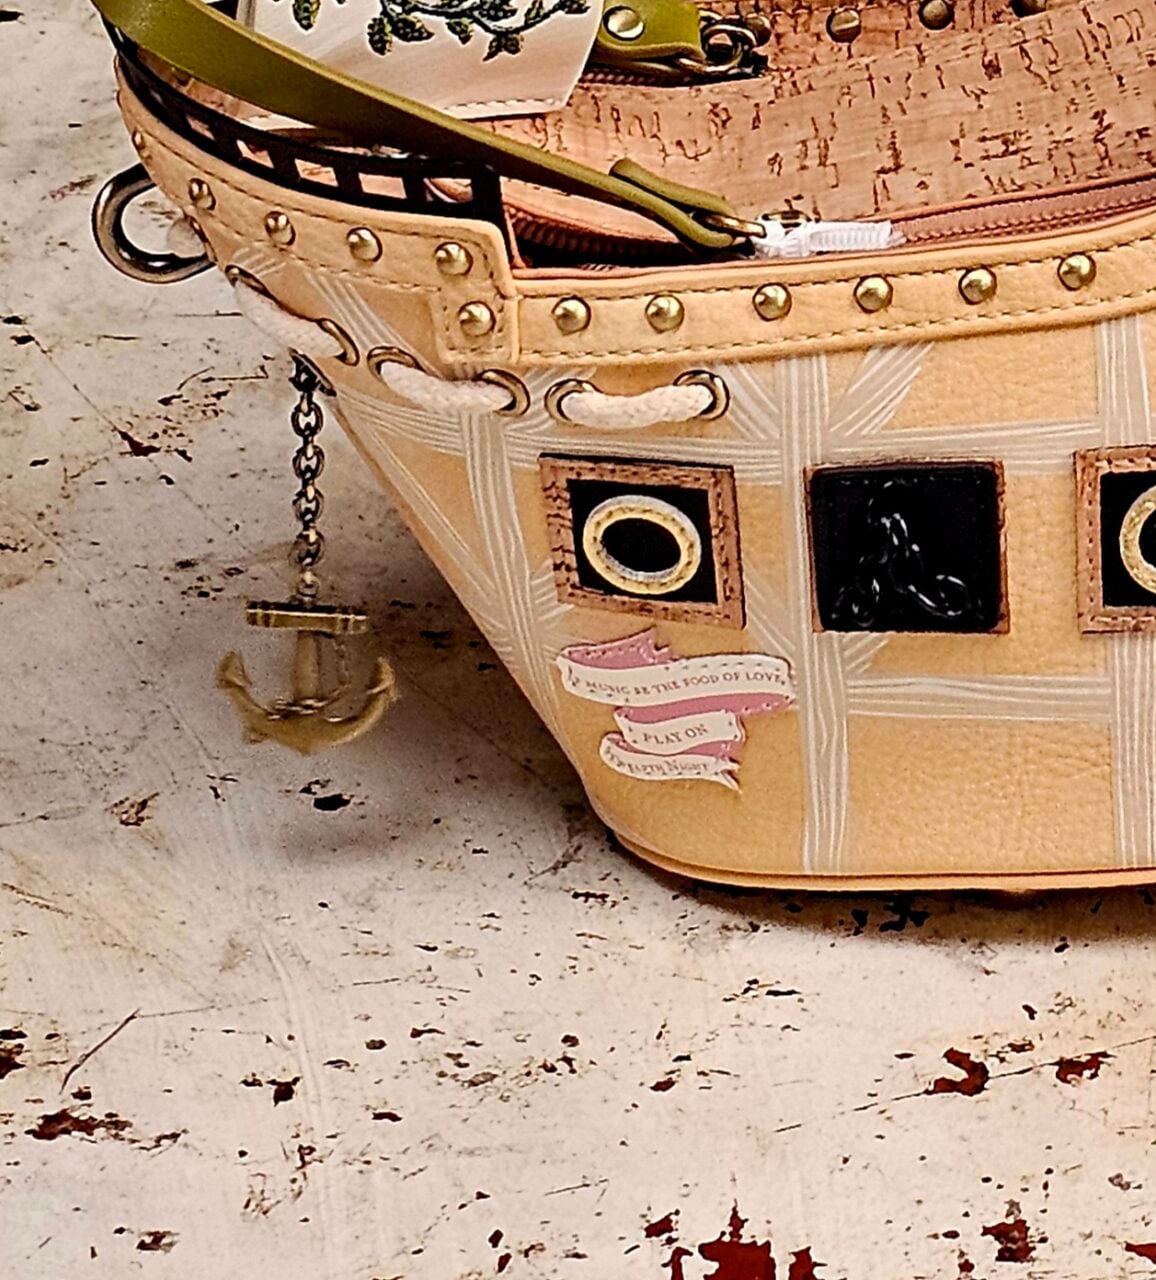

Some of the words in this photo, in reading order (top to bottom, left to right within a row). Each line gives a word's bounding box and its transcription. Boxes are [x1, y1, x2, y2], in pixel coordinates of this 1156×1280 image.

[651, 680, 681, 694] THE
[682, 674, 719, 688] FOOD
[722, 671, 740, 682] OF
[643, 732, 683, 745] PLAY
[685, 723, 708, 738] ON
